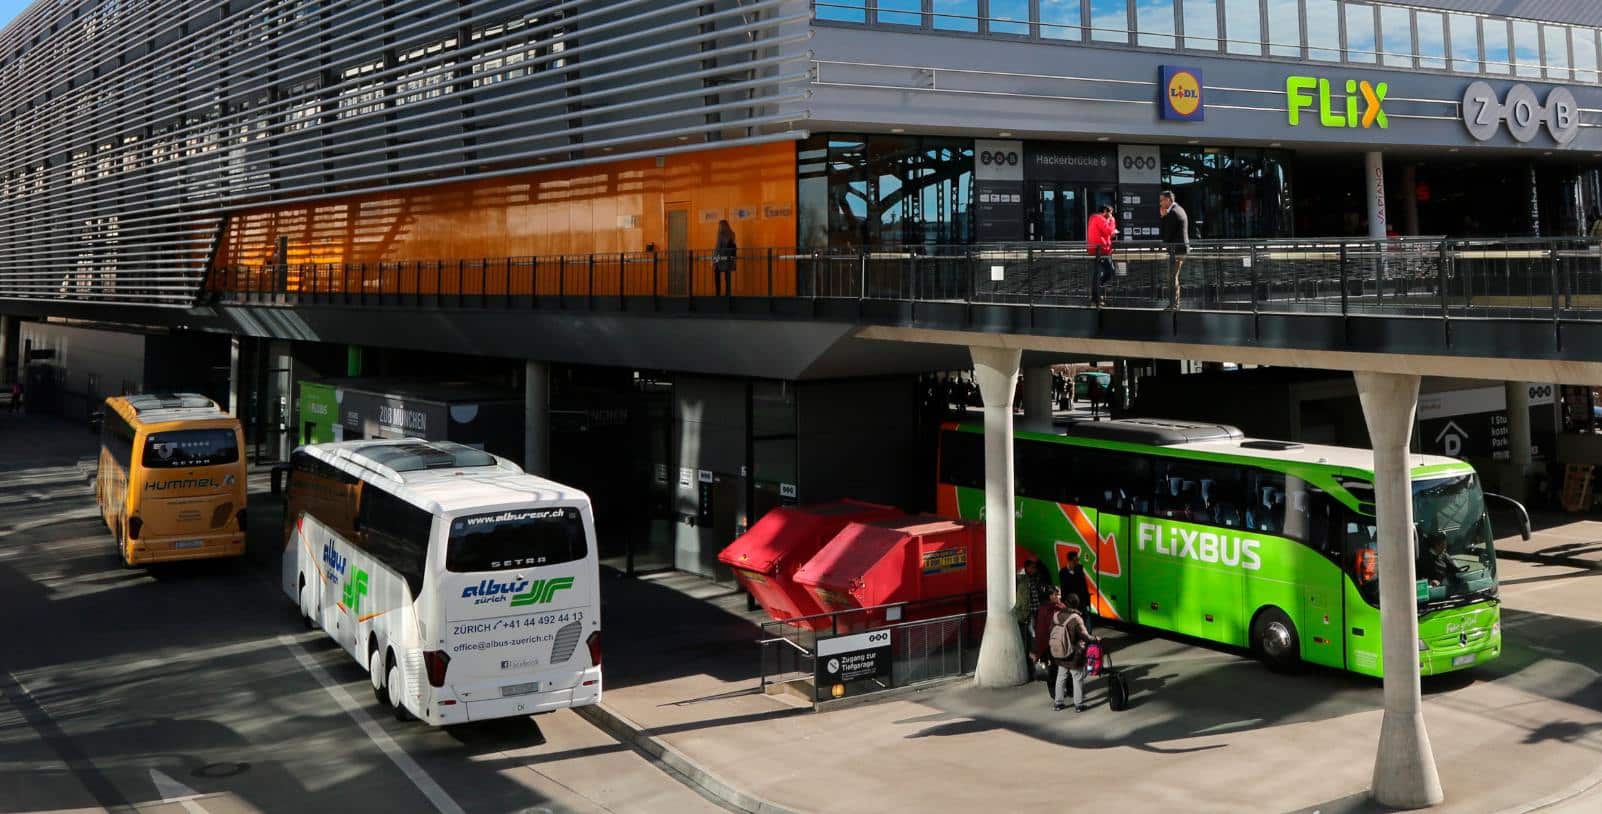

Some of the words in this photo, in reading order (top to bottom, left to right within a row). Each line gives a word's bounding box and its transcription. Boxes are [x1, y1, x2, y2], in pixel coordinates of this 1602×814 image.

[491, 557, 547, 568] SETRA
[462, 579, 529, 598] albus
[474, 595, 507, 605] zürich
[453, 623, 492, 636] ZÜRICH
[503, 619, 520, 630] +41
[523, 617, 536, 627] 44
[538, 615, 555, 625] 492
[558, 613, 569, 623] 44
[572, 611, 583, 621] 13
[453, 634, 554, 652] office@albus-zuerich.ch
[841, 654, 865, 664] Zugang
[866, 652, 877, 660] zur
[841, 660, 875, 672] Tiefgarage
